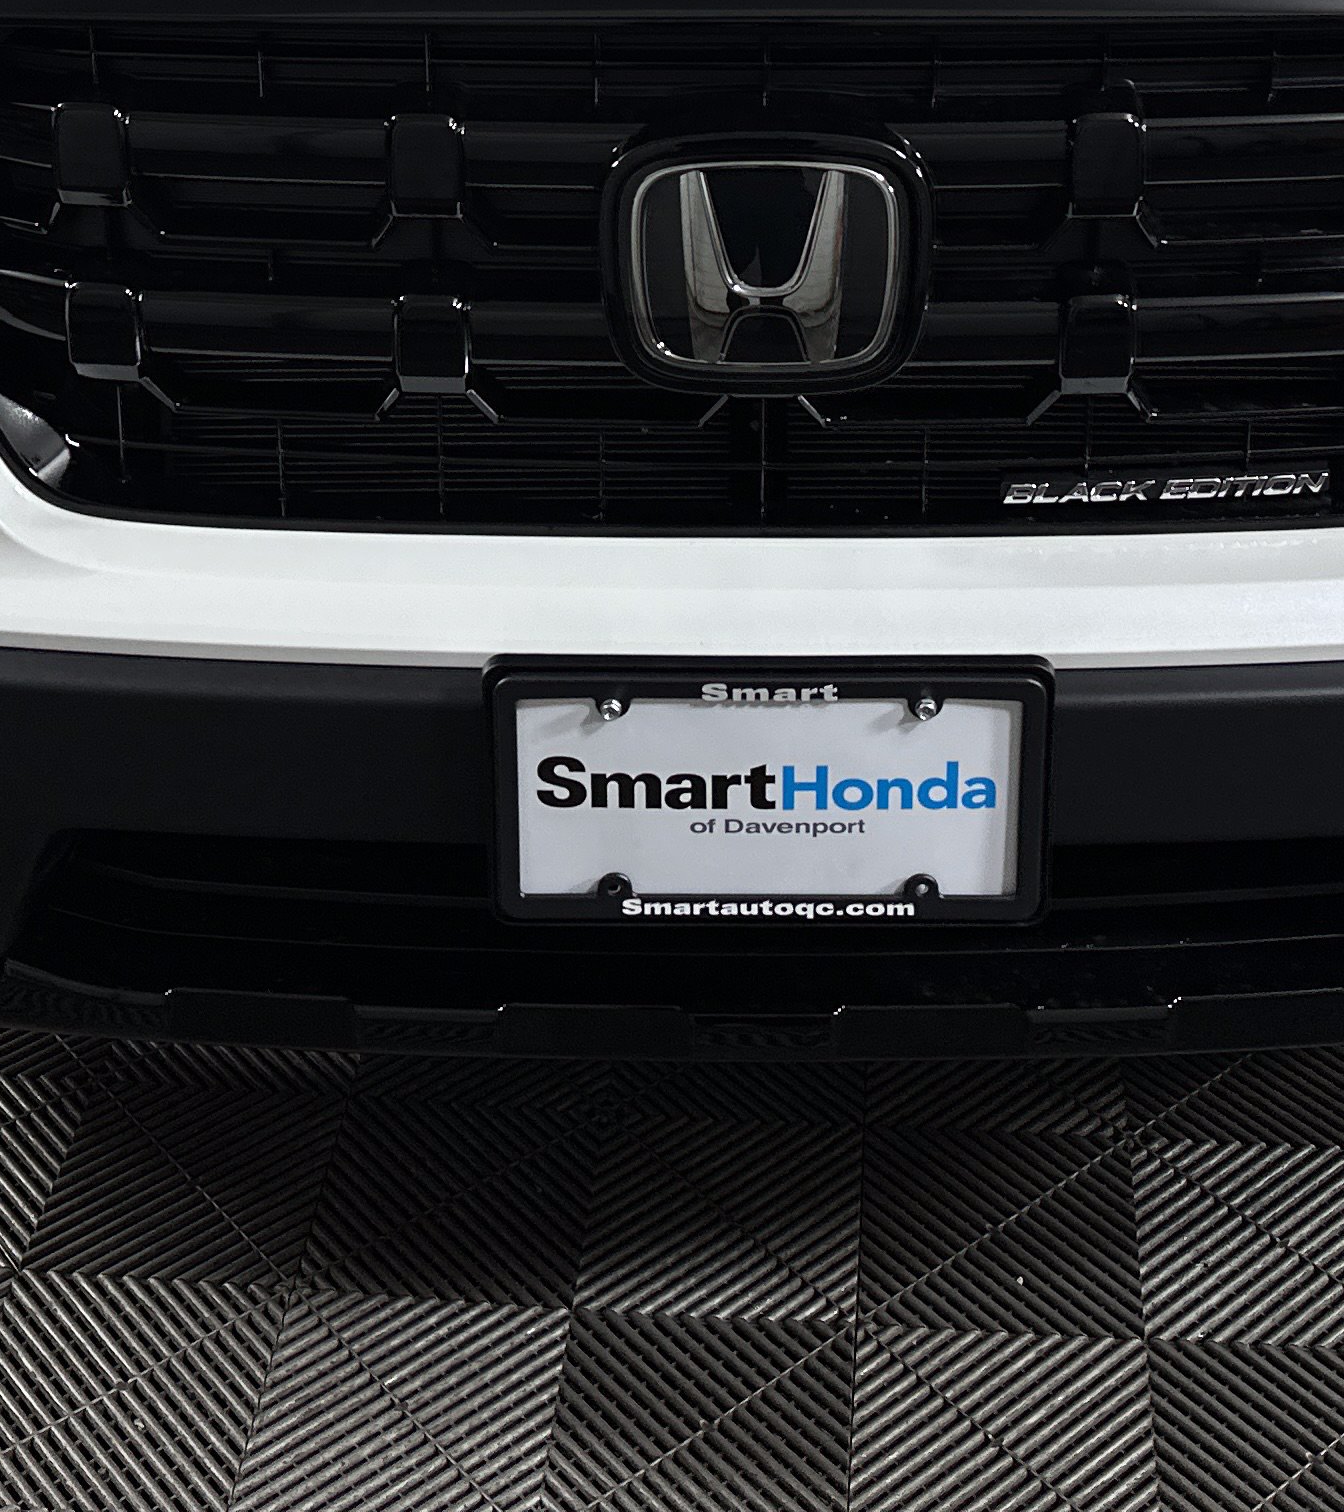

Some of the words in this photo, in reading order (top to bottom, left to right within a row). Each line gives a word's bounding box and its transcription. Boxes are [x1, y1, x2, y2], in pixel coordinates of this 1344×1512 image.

[1003, 479, 1155, 504] BLACK
[1159, 472, 1329, 500] EDITION
[701, 683, 838, 702] Smart
[689, 819, 717, 834] of
[723, 819, 866, 837] Davenport
[621, 898, 916, 919] Smartautoqc.com
